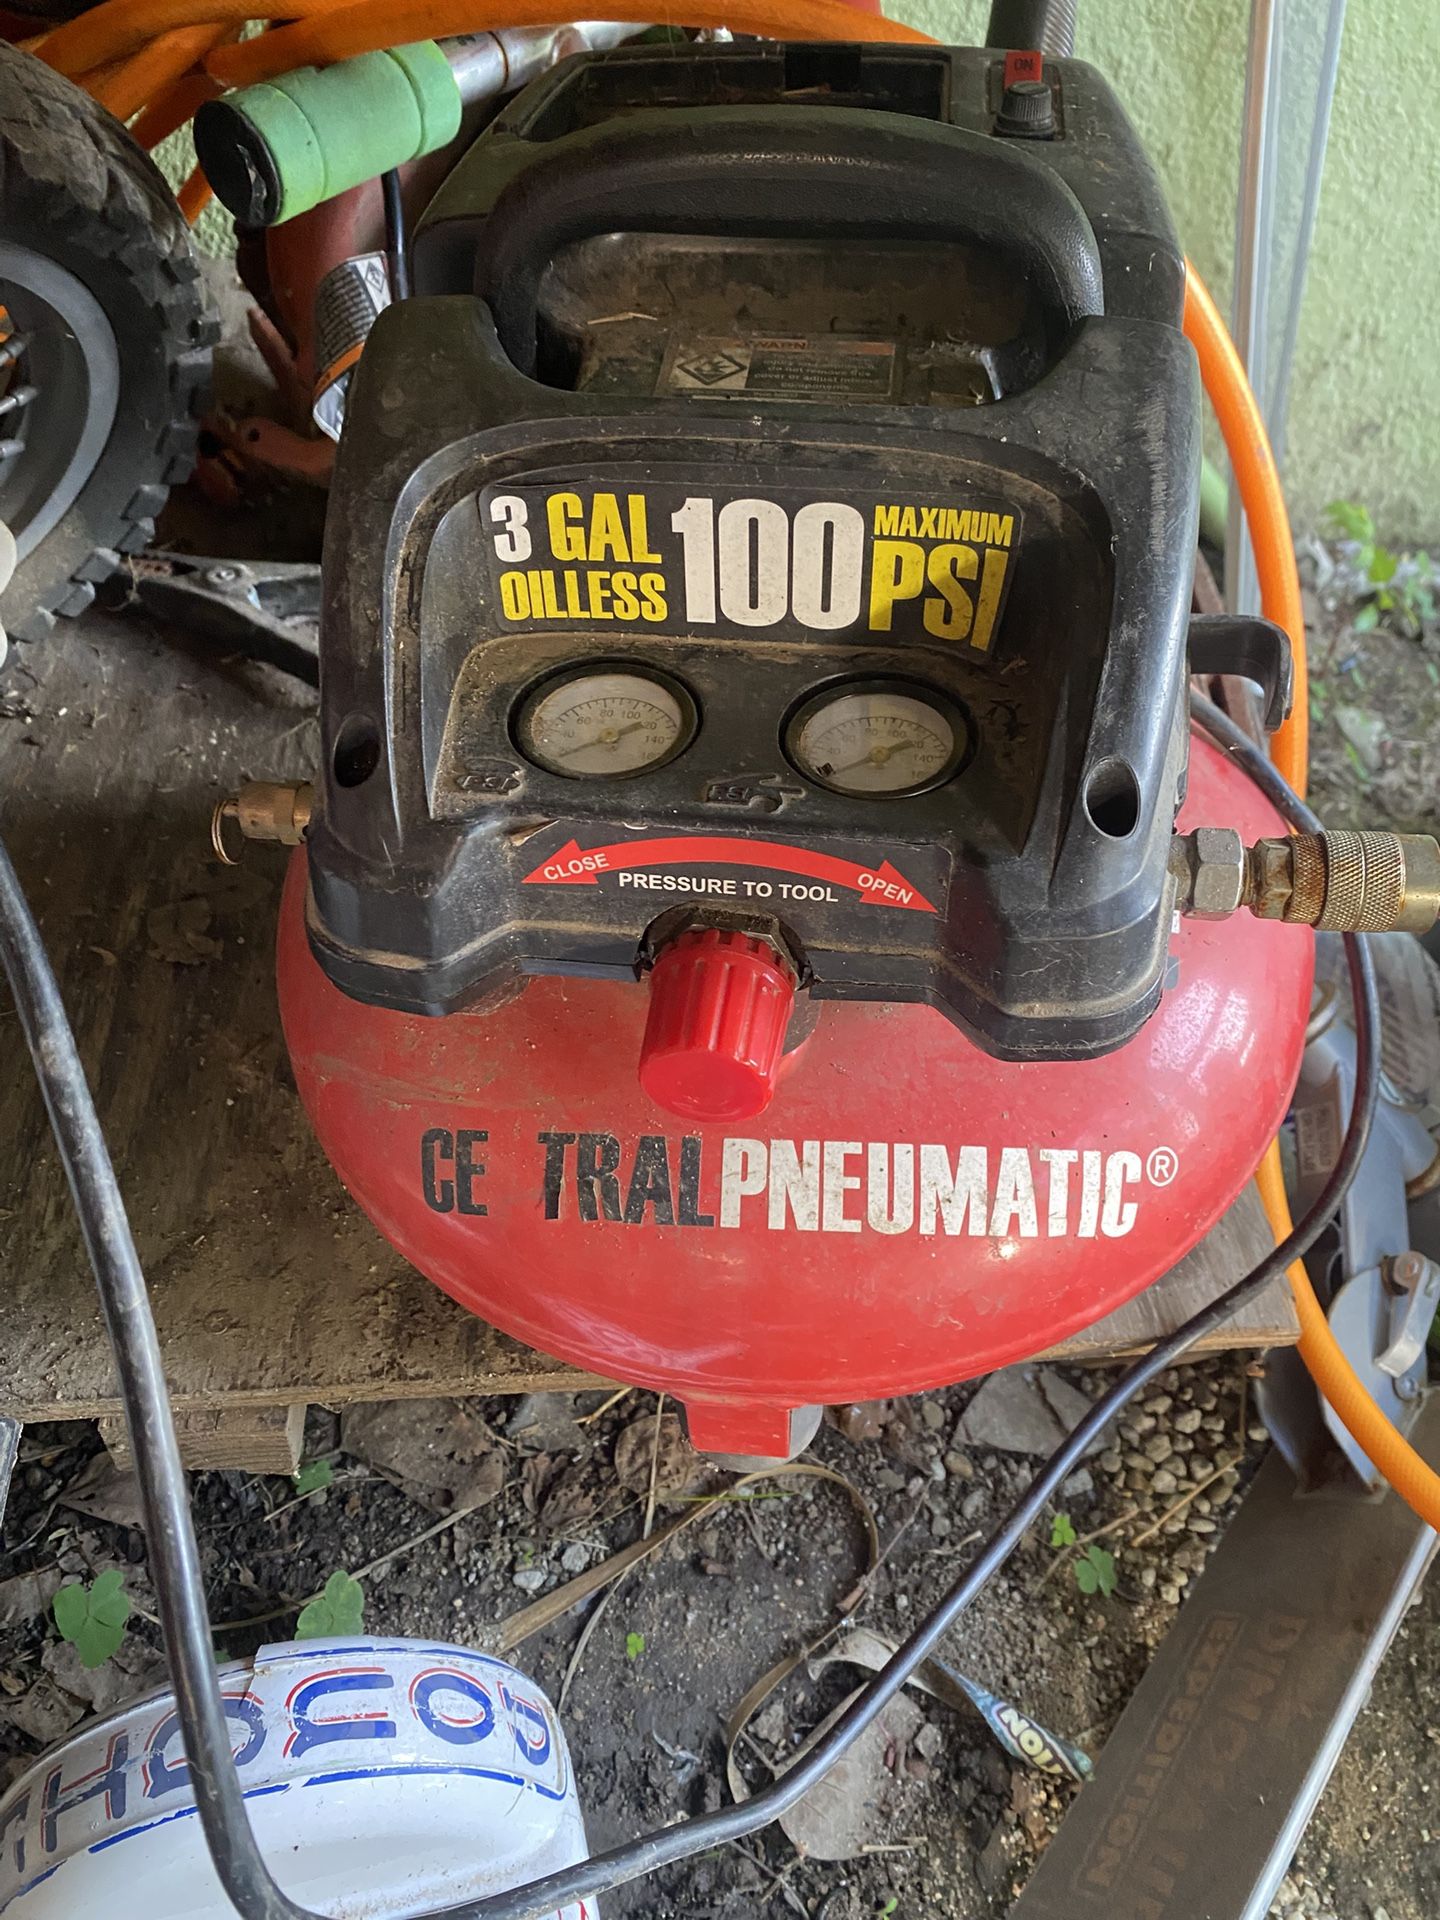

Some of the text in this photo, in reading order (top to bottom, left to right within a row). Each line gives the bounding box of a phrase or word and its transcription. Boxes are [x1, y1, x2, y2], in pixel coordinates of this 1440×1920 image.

[1014, 57, 1034, 71] ON
[490, 493, 662, 564] 3 GAL
[874, 505, 1014, 547] MAXIMUM
[671, 498, 865, 630] 100
[500, 570, 668, 622] OILLESS
[869, 540, 1009, 651] PSI
[621, 711, 641, 720] 100
[645, 736, 665, 745] 140
[913, 754, 934, 763] 140
[543, 853, 610, 881] CLOSE
[618, 872, 839, 903] PRESSURE TO TOOL
[857, 872, 913, 905] OPEN
[421, 1127, 715, 1228] CETRAL
